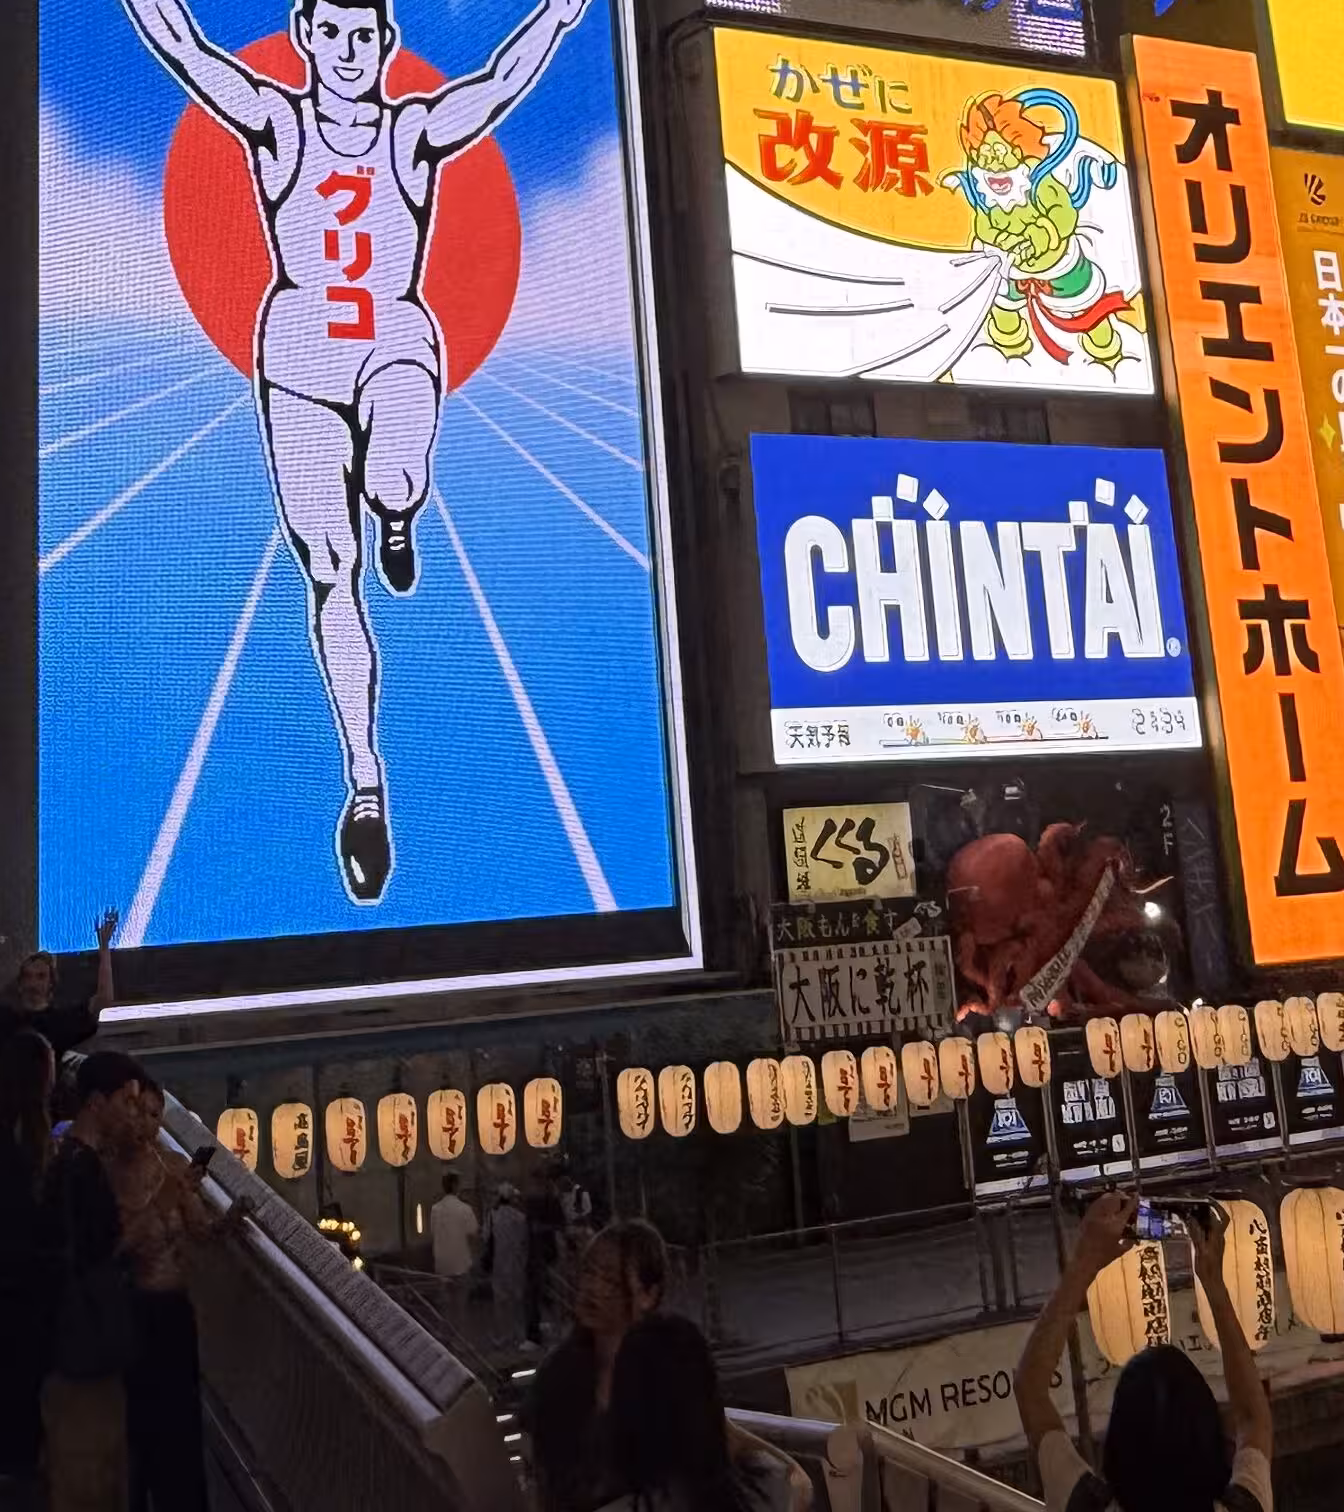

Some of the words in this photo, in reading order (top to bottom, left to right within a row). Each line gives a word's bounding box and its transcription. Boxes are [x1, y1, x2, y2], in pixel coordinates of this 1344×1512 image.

[767, 54, 914, 115] かぜに
[753, 109, 937, 199] 改源
[314, 165, 377, 341] グリコ
[810, 817, 890, 886] くくる
[864, 1387, 933, 1428] MGM
